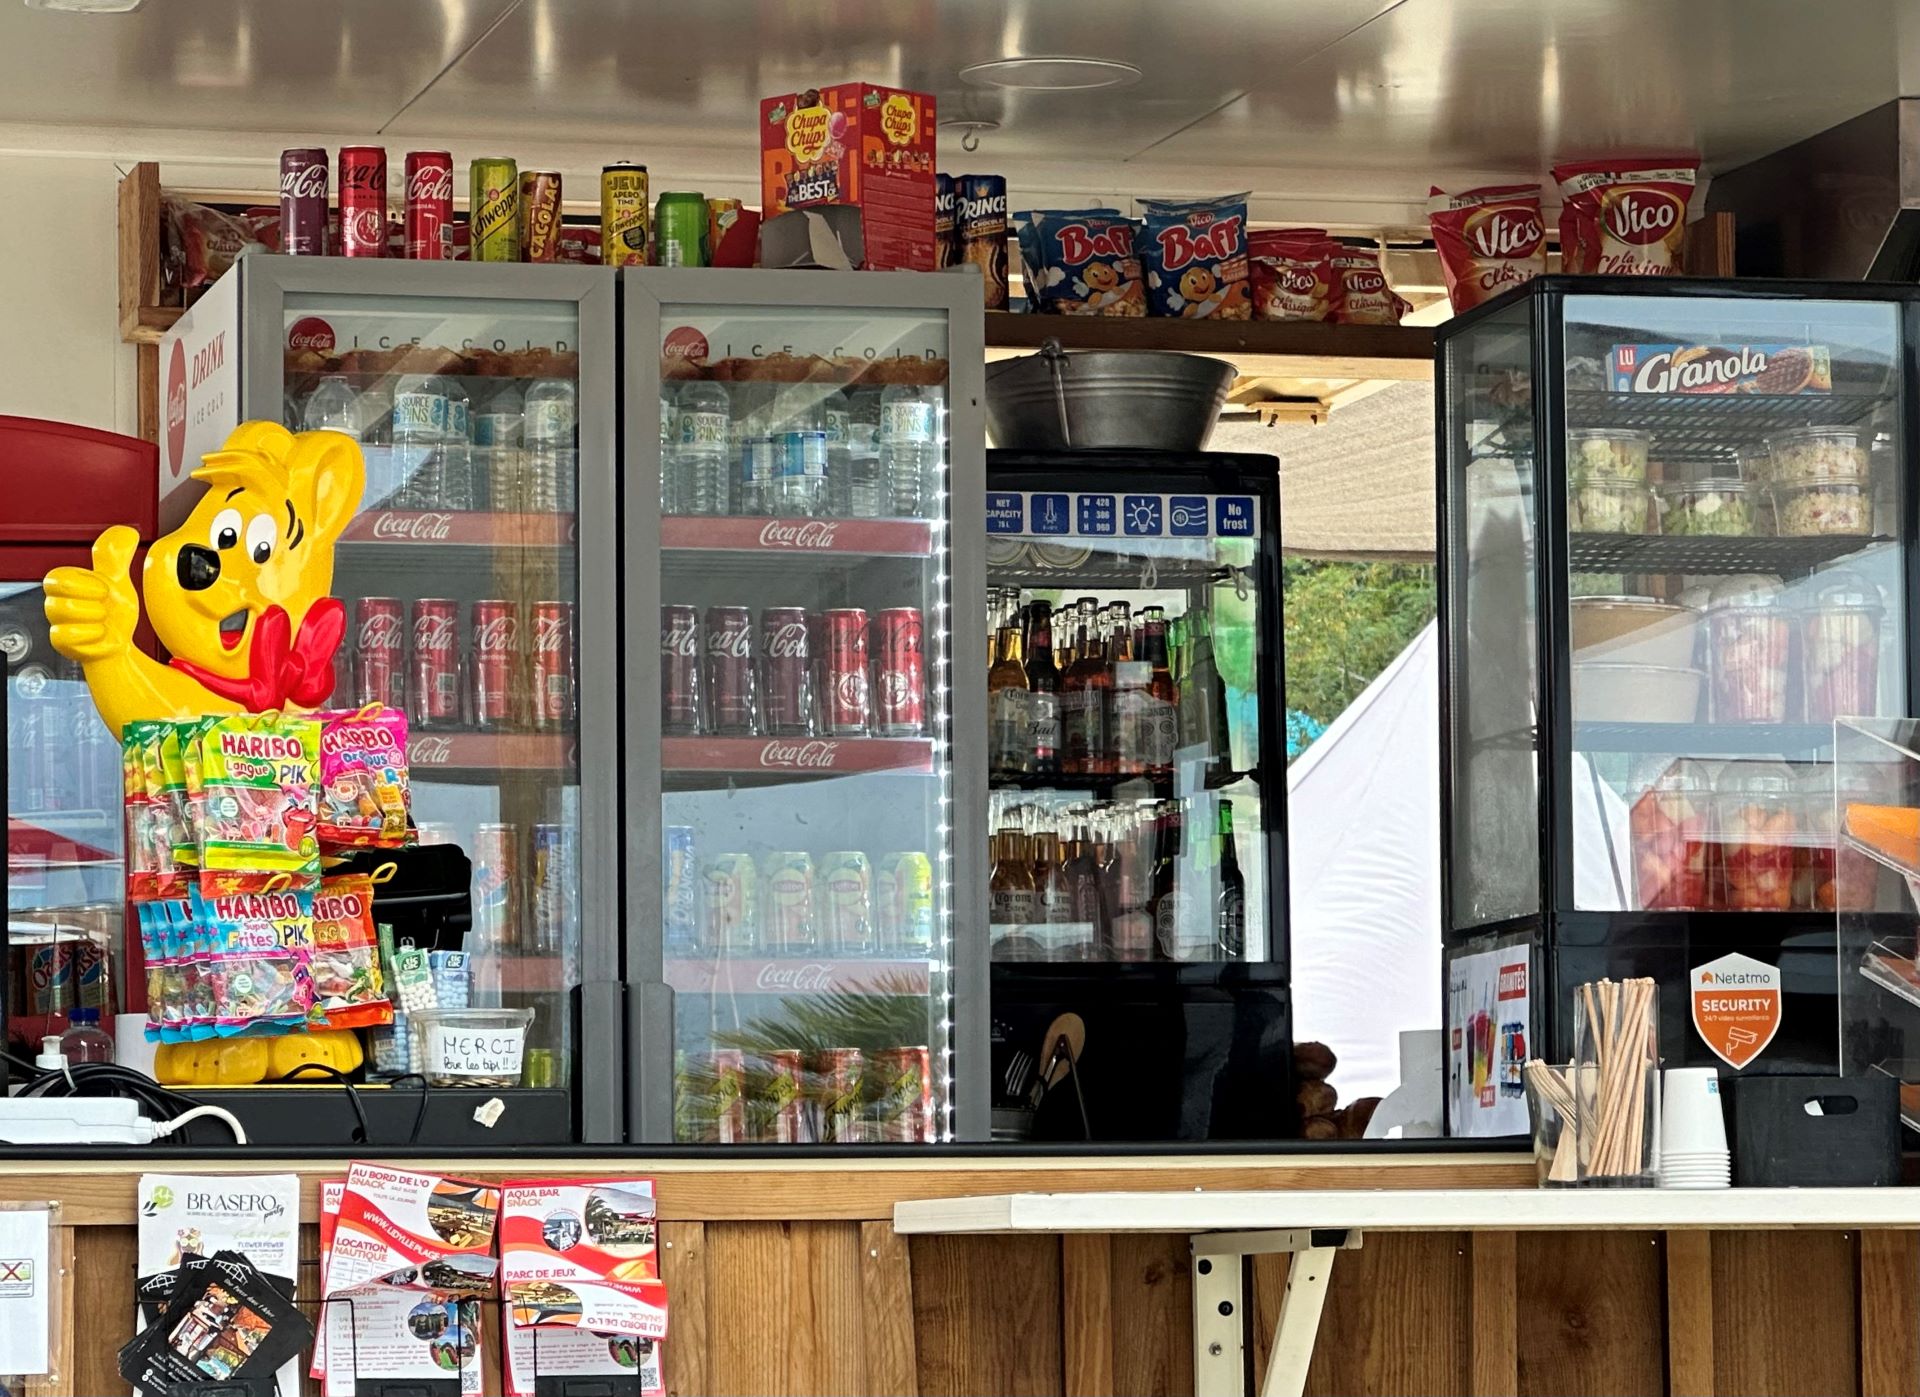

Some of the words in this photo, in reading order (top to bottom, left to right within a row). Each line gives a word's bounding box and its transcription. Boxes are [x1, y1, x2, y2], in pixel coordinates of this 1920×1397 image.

[886, 104, 912, 120] Chupa
[792, 113, 827, 131] Chupa
[884, 117, 911, 137] Chups
[790, 130, 826, 154] Chups
[799, 179, 830, 200] BEST
[530, 177, 560, 258] CACOLAC
[956, 194, 1006, 224] PRINCE
[1614, 194, 1675, 238] Vico
[607, 211, 646, 237] Schweppes
[1475, 213, 1542, 258] Vico
[1622, 250, 1634, 264] la
[1346, 274, 1383, 291] Vico
[192, 330, 226, 390] DRINK
[1620, 348, 1634, 366] LU
[1634, 347, 1768, 394] Granola
[1228, 503, 1242, 516] No
[1223, 517, 1248, 531] frost
[221, 733, 302, 758] HARIBO
[322, 726, 395, 755] HARBO
[225, 758, 269, 779] Langue
[215, 893, 300, 922] HARIBO
[243, 921, 269, 931] Super
[227, 930, 273, 949] Frites
[33, 944, 73, 990] Oasis
[76, 943, 105, 978] asis
[403, 962, 418, 971] tac
[406, 955, 419, 964] tic
[447, 960, 462, 968] tac
[450, 954, 462, 962] tic
[1715, 972, 1771, 984] Netatmo
[1702, 998, 1771, 1012] SECURITY
[443, 1036, 516, 1055] MERCI
[466, 1057, 480, 1070] les
[350, 1177, 386, 1190] SNACK
[352, 1168, 368, 1178] AU
[369, 1170, 397, 1182] BORD
[399, 1176, 412, 1186] DE
[326, 1188, 341, 1196] AU
[507, 1189, 537, 1199] AQUA
[539, 1188, 560, 1198] BAR
[187, 1193, 277, 1212] BRASERO
[507, 1199, 543, 1208] SNACK
[336, 1236, 388, 1252] LOCATION
[334, 1246, 388, 1262] NAUTIQUE
[506, 1270, 534, 1279] PARC
[535, 1269, 549, 1278] DE
[551, 1268, 577, 1278] JEUX
